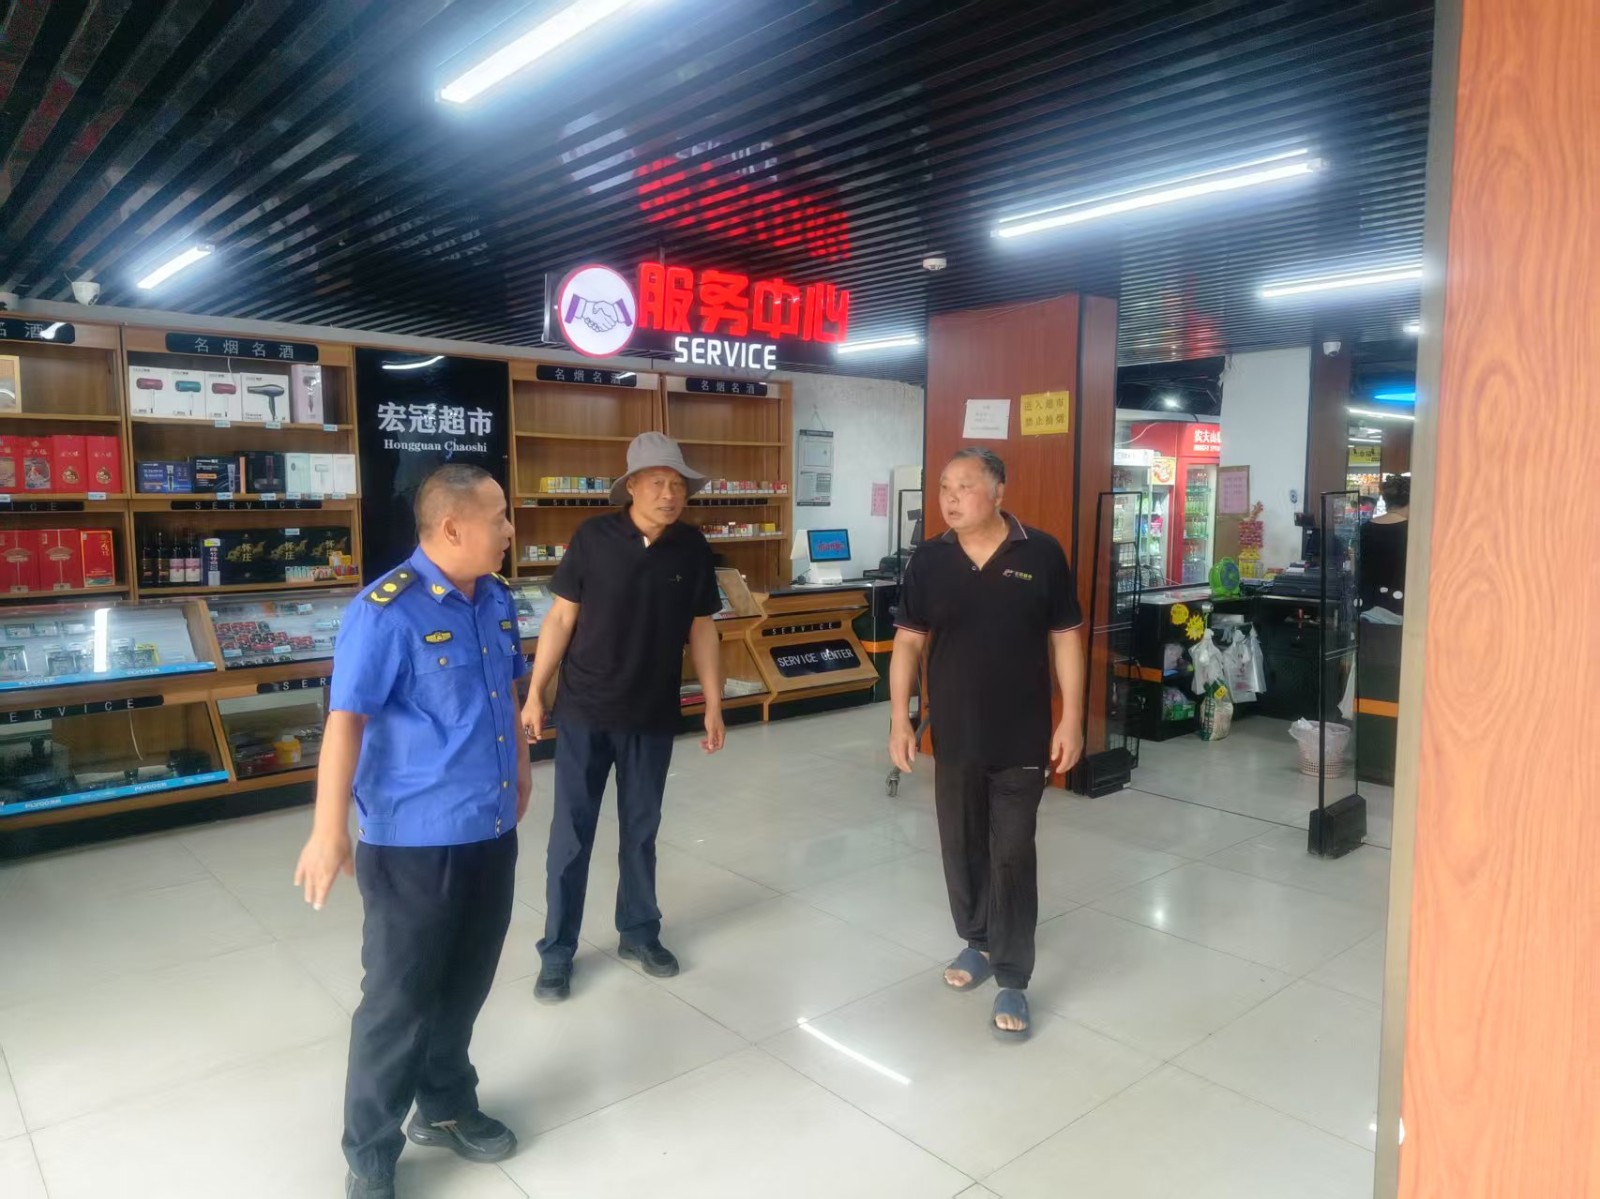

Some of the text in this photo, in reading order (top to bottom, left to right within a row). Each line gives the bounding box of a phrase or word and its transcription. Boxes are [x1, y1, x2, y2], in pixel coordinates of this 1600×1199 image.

[638, 262, 850, 344] 服务中心
[194, 337, 294, 359] 名烟名酒
[674, 336, 777, 370] SERVICE
[700, 380, 755, 395] 名烟名酒
[377, 401, 494, 436] 宏冠超市
[383, 439, 488, 452] Hongguan Chaoshi
[194, 501, 300, 510] SERVICE
[772, 622, 833, 636] SERVICE
[777, 652, 819, 668] SERVICE
